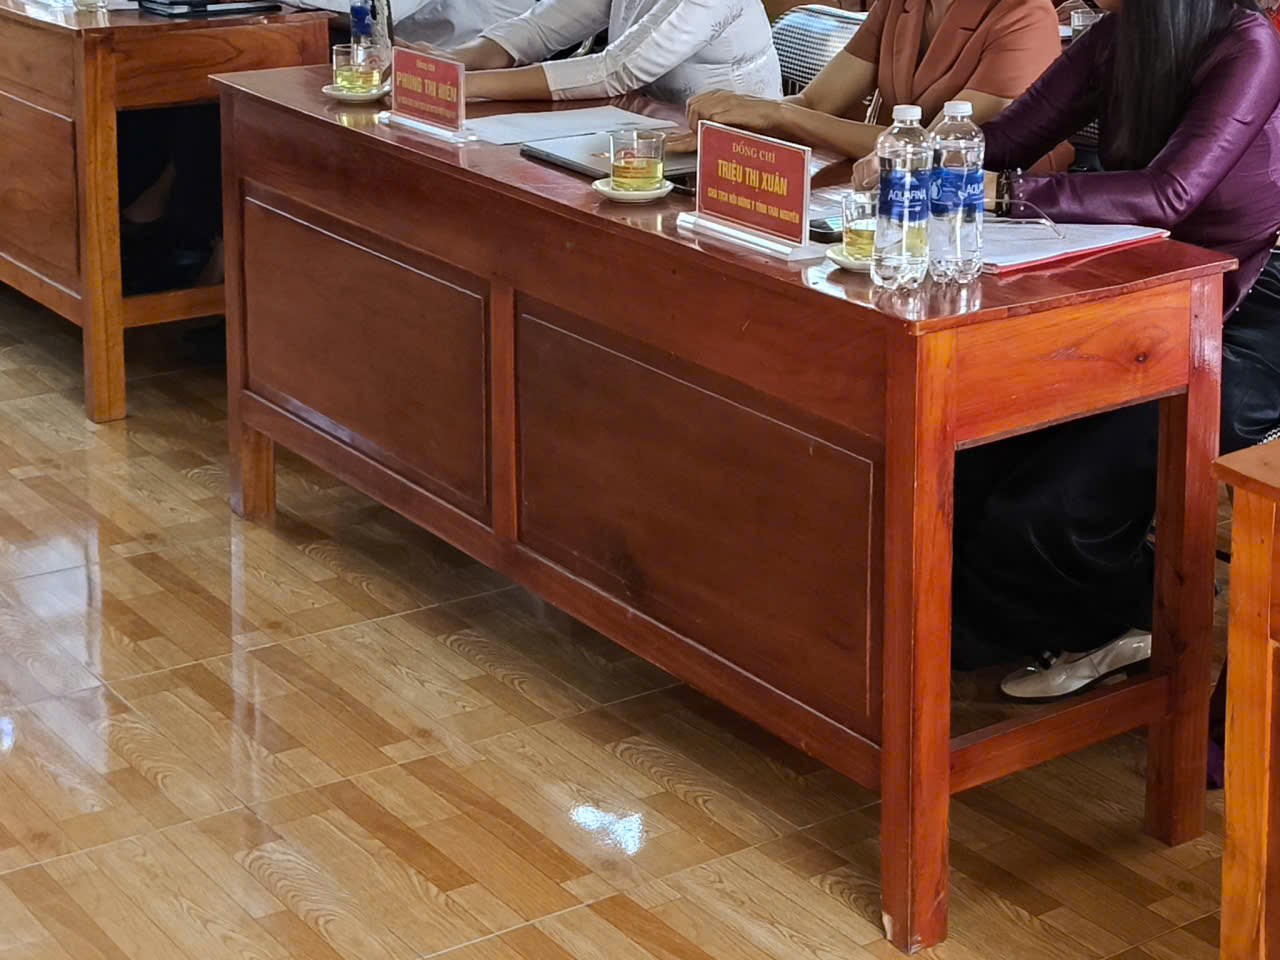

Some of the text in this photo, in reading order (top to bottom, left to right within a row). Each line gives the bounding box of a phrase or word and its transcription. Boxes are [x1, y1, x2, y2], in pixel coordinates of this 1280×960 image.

[717, 159, 788, 197] TRIỆU THỊ XUÂN
[887, 187, 928, 202] AQUAFINA
